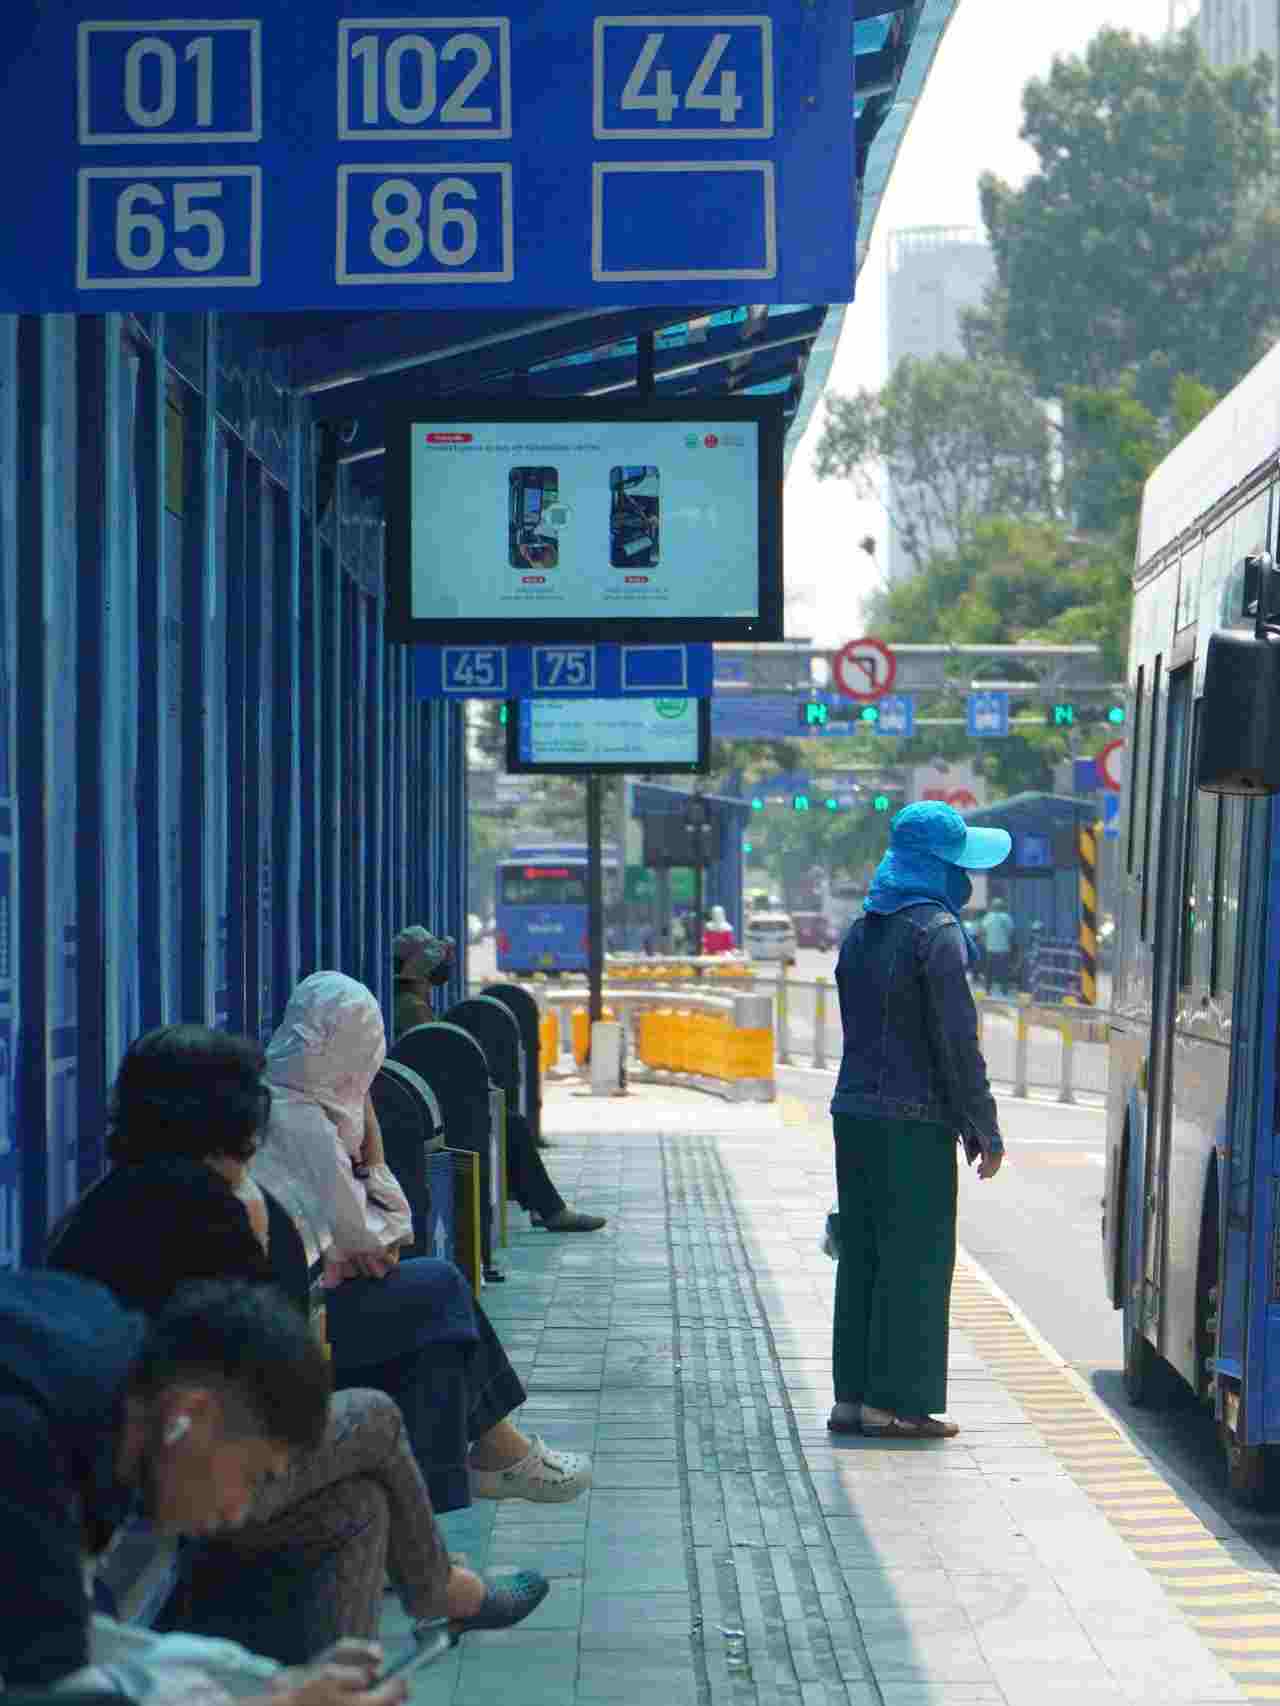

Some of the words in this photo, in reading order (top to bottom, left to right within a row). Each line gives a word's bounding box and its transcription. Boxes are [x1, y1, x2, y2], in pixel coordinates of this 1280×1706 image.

[124, 37, 213, 127] 01
[350, 33, 493, 125] 102
[620, 33, 743, 122] 44
[115, 181, 225, 271] 65
[369, 178, 478, 266] 86
[453, 652, 494, 685] 45
[546, 652, 586, 685] 75
